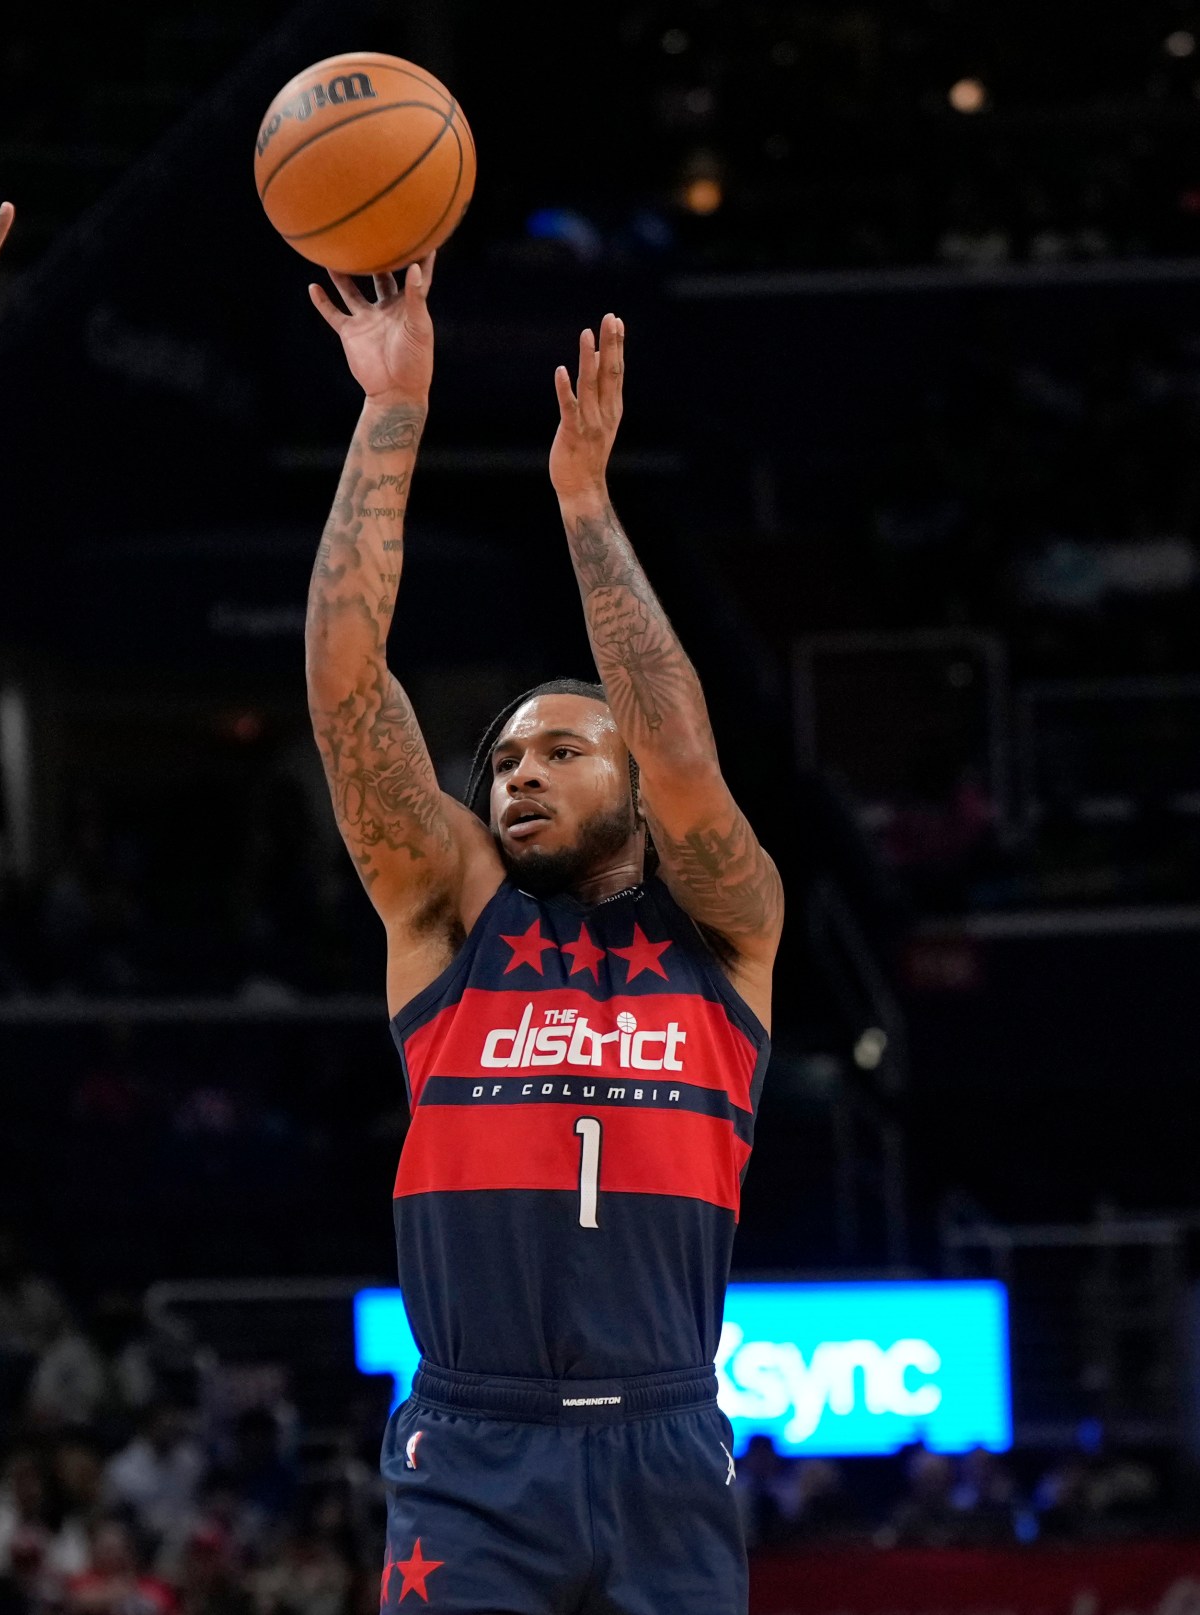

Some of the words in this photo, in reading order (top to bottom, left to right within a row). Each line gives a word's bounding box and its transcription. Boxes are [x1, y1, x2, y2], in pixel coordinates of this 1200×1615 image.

[544, 1009, 578, 1024] THE
[481, 1002, 687, 1071] district
[472, 1085, 502, 1097] OF
[522, 1083, 680, 1101] COLUMBIA
[574, 1116, 603, 1229] 1
[562, 1396, 621, 1407] WASHINGTON
